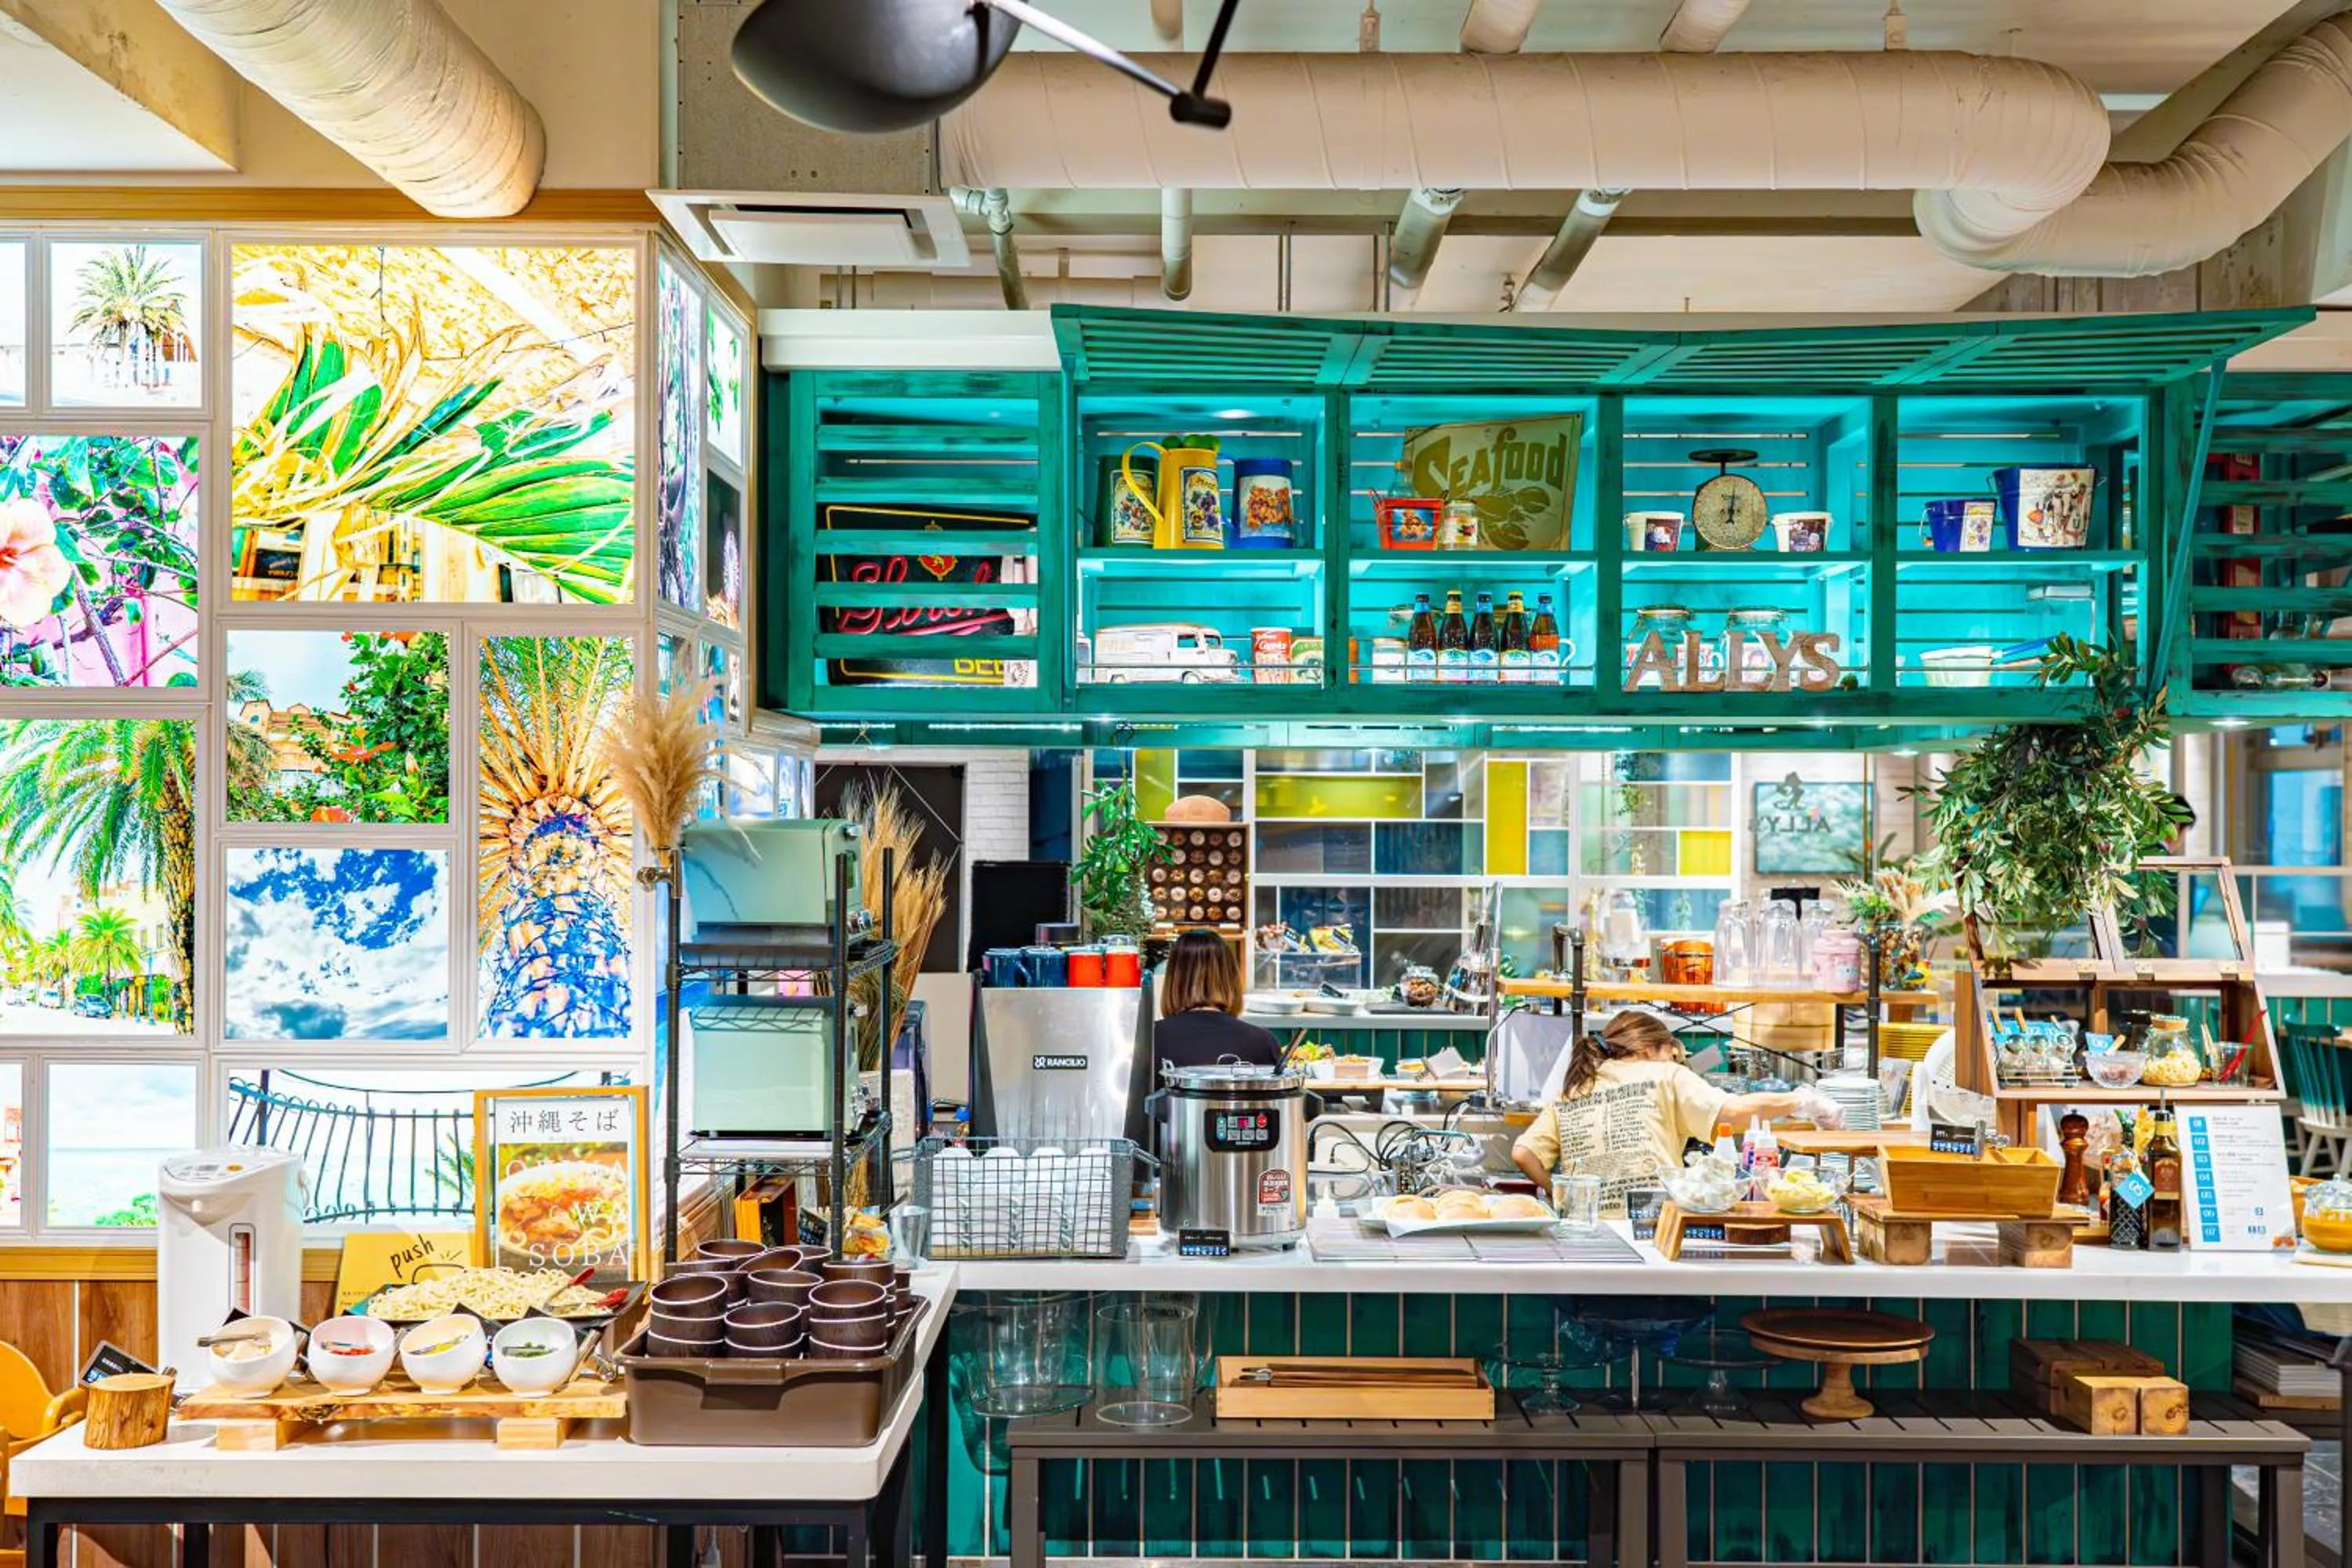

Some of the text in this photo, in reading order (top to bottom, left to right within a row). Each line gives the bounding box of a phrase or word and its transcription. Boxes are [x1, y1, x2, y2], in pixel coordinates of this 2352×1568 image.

[1622, 629, 1841, 692] ALLYS
[510, 1109, 619, 1134] 沖縄そば
[389, 1233, 435, 1279] push
[528, 1242, 629, 1268] SOBA
